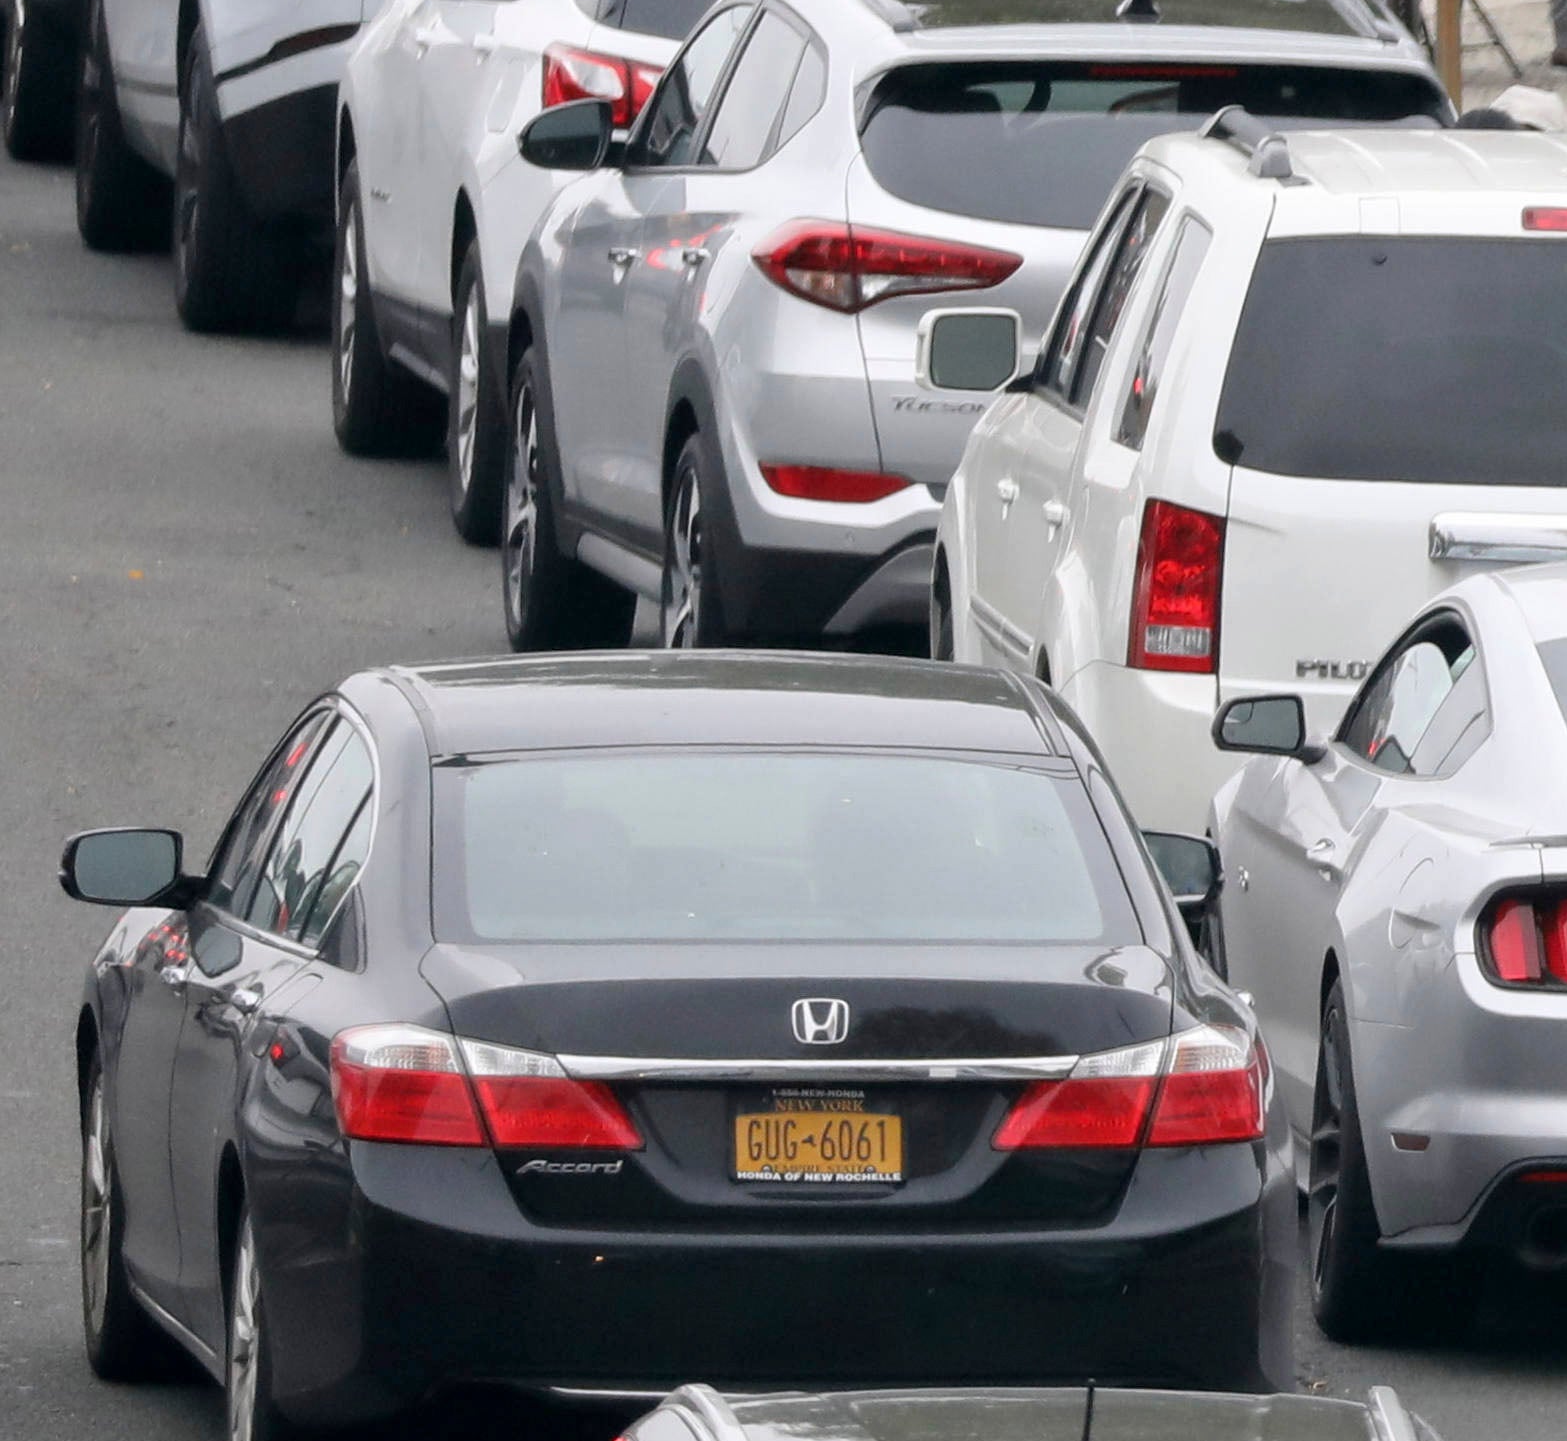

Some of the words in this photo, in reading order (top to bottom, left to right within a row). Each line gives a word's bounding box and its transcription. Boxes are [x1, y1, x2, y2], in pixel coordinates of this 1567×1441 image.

[1297, 660, 1370, 680] PILO
[775, 1100, 814, 1111] NEW
[820, 1100, 864, 1112] YORK
[516, 1160, 624, 1174] Accord
[737, 1171, 781, 1181] HONDA
[784, 1171, 800, 1181] OF
[804, 1172, 833, 1181] NEW
[835, 1172, 901, 1181] ROCHELLE
